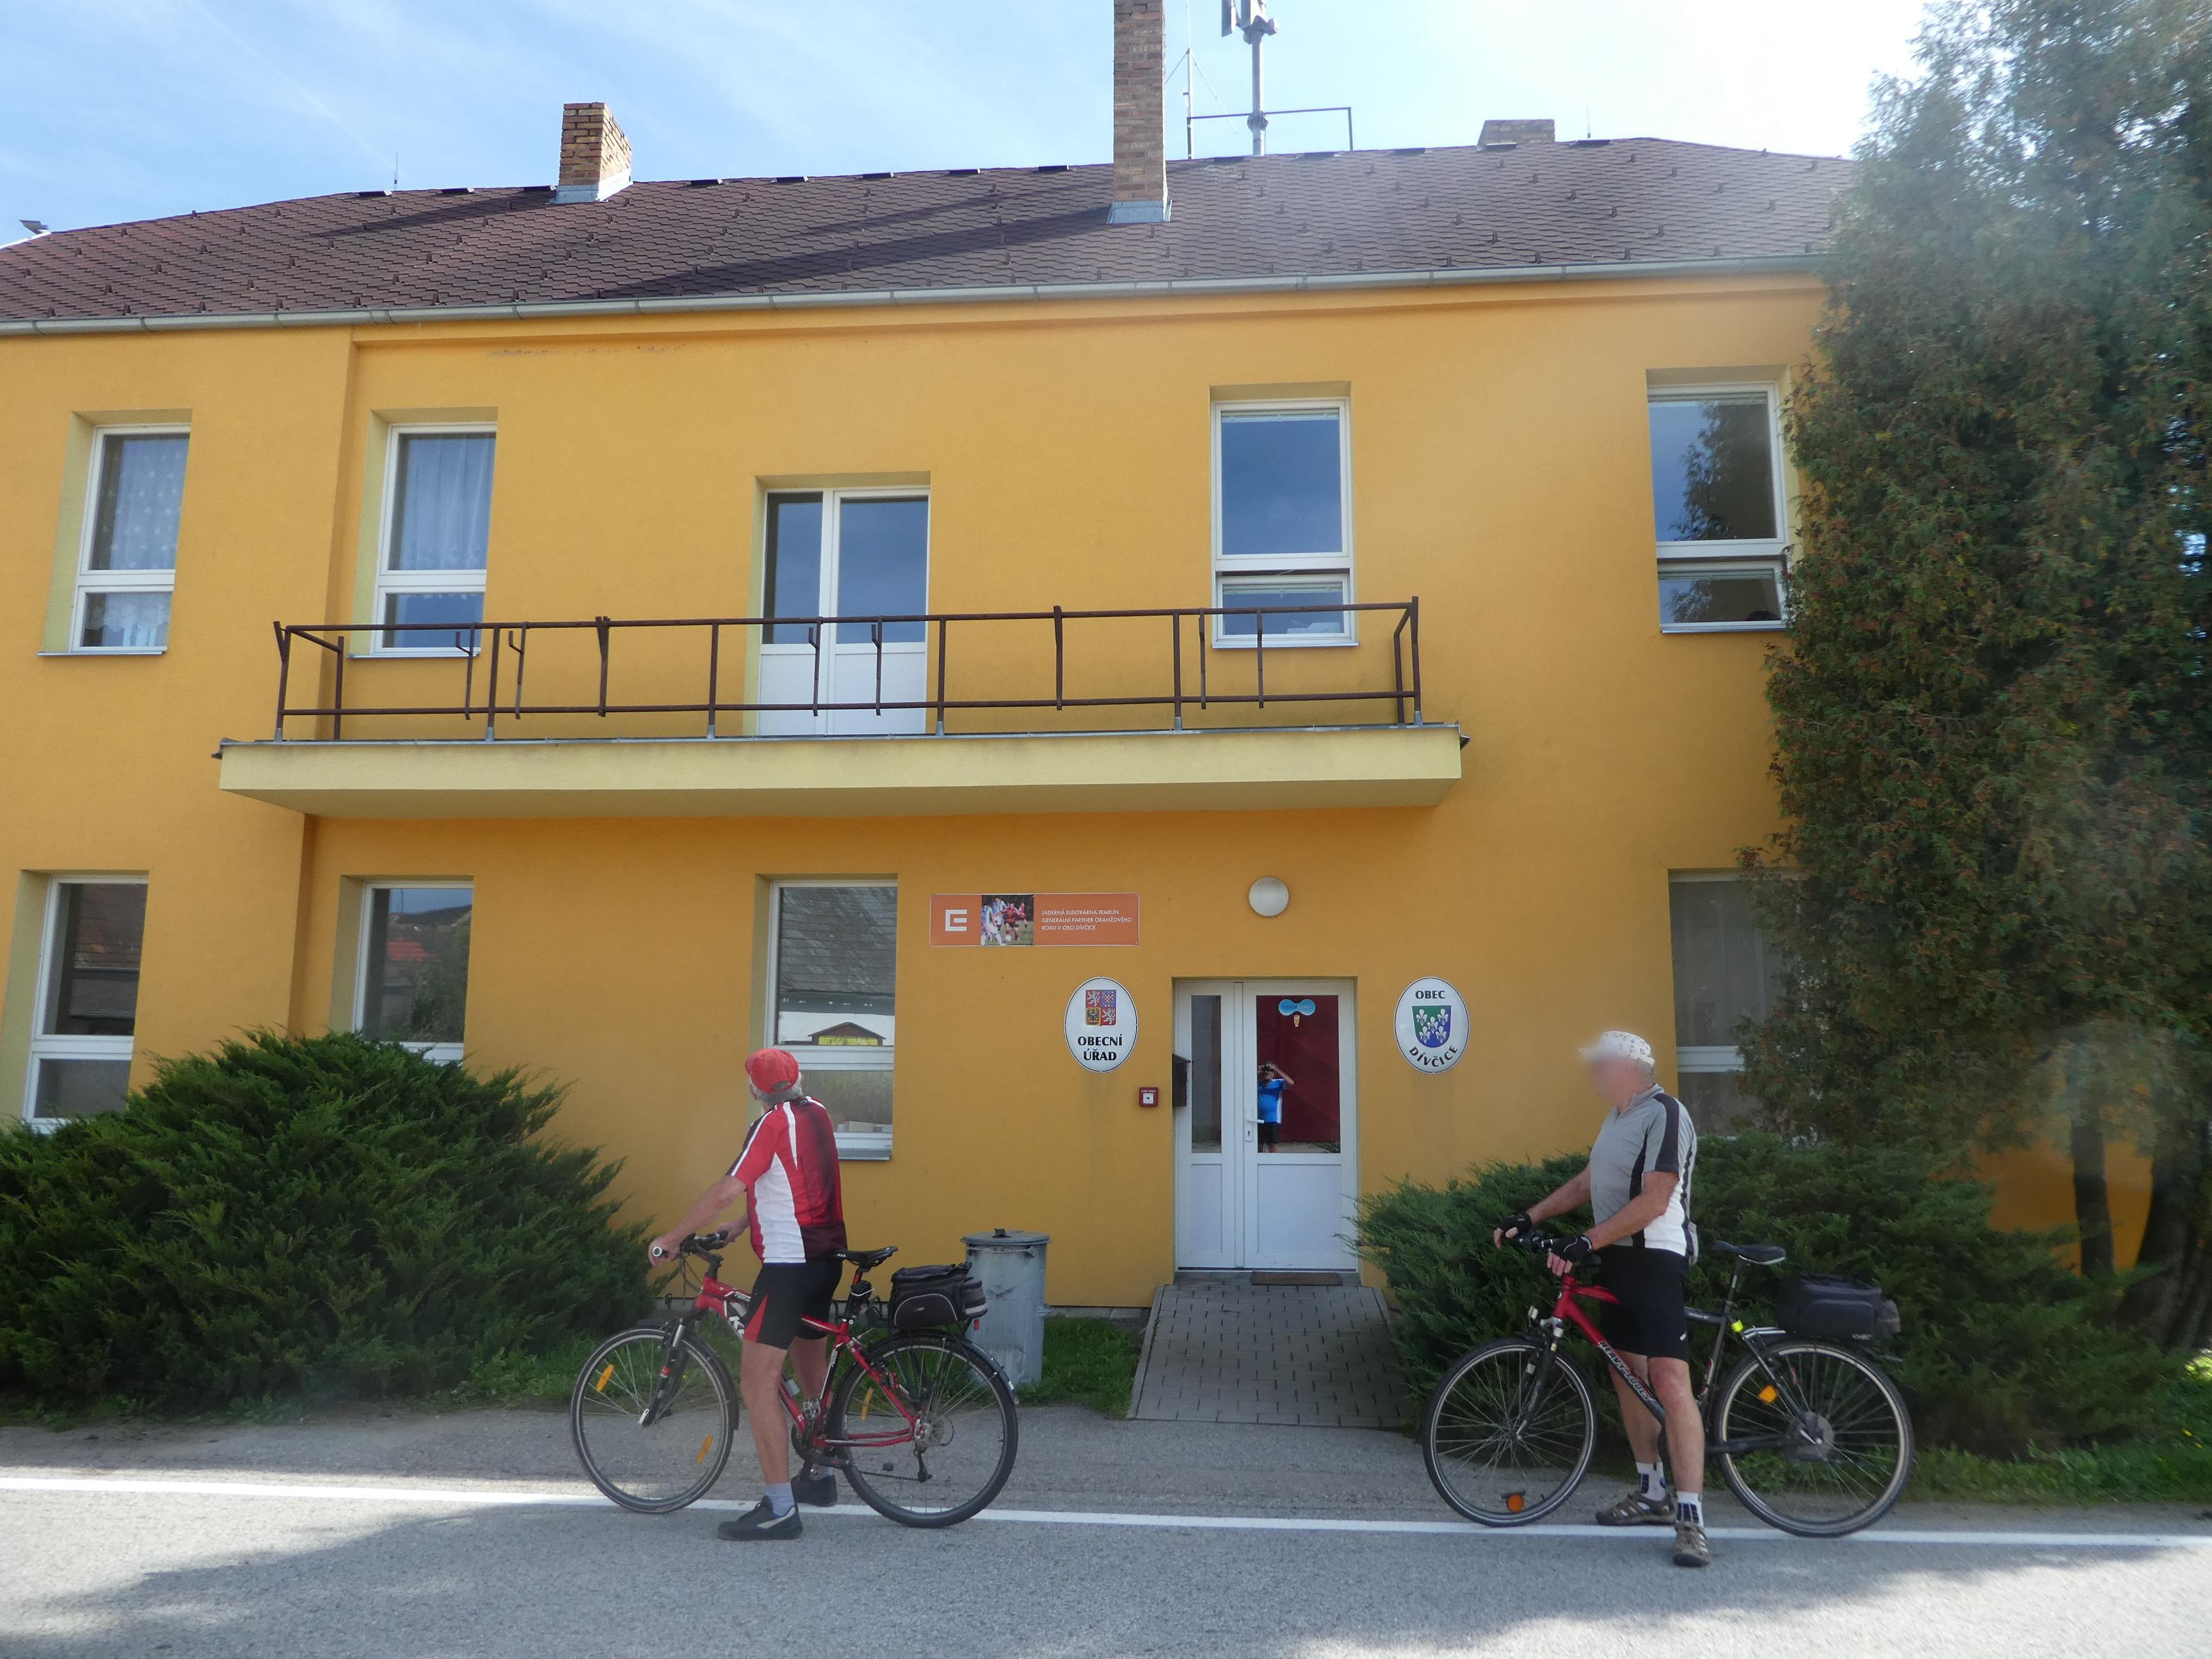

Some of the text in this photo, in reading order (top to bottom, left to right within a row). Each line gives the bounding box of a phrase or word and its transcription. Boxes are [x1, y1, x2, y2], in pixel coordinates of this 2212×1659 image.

[1415, 990, 1445, 999] OBEC
[1077, 1034, 1123, 1046] OBECNÍ
[1083, 1048, 1117, 1061] ÚŘAD
[1409, 1045, 1458, 1067] DÍVČICE
